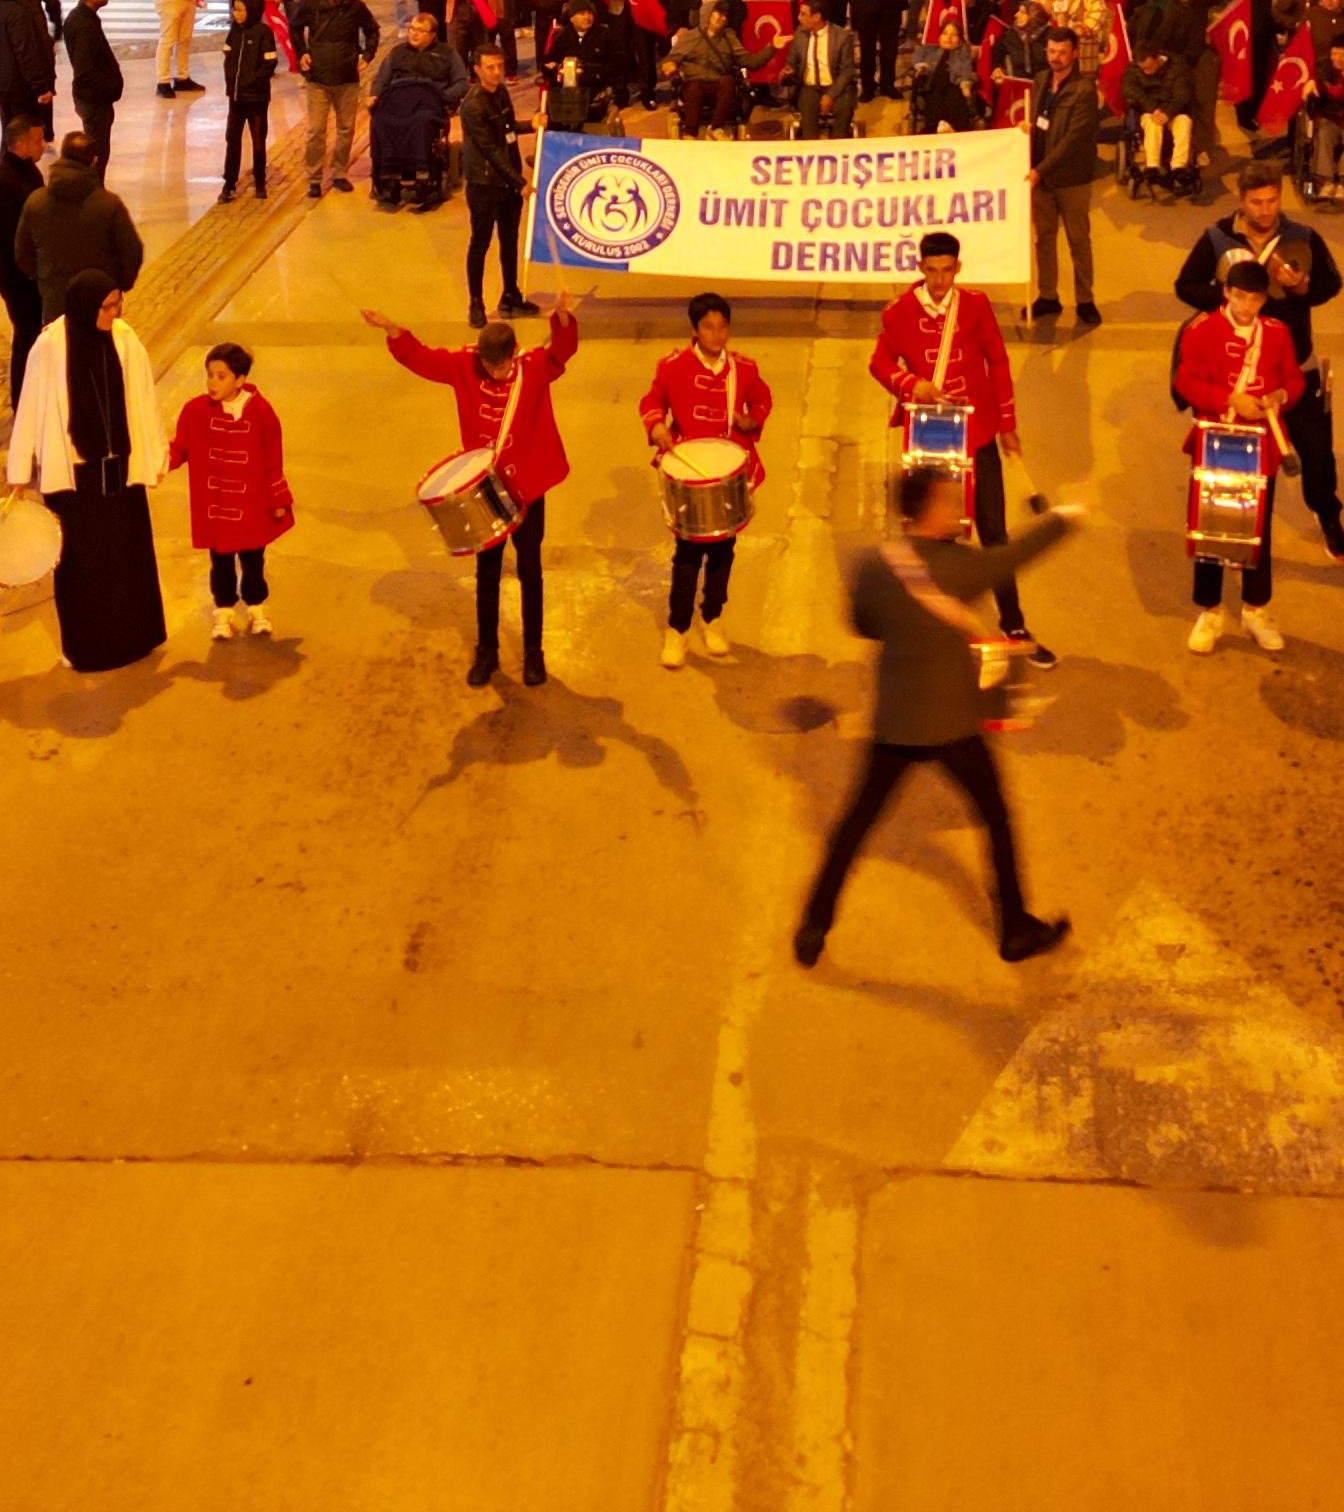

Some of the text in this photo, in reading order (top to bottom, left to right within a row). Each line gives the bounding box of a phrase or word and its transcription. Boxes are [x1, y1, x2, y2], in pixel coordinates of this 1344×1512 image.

[698, 187, 1007, 232] ÜMİT ÇOCUKLARI
[771, 232, 920, 272] DERNEĞ
